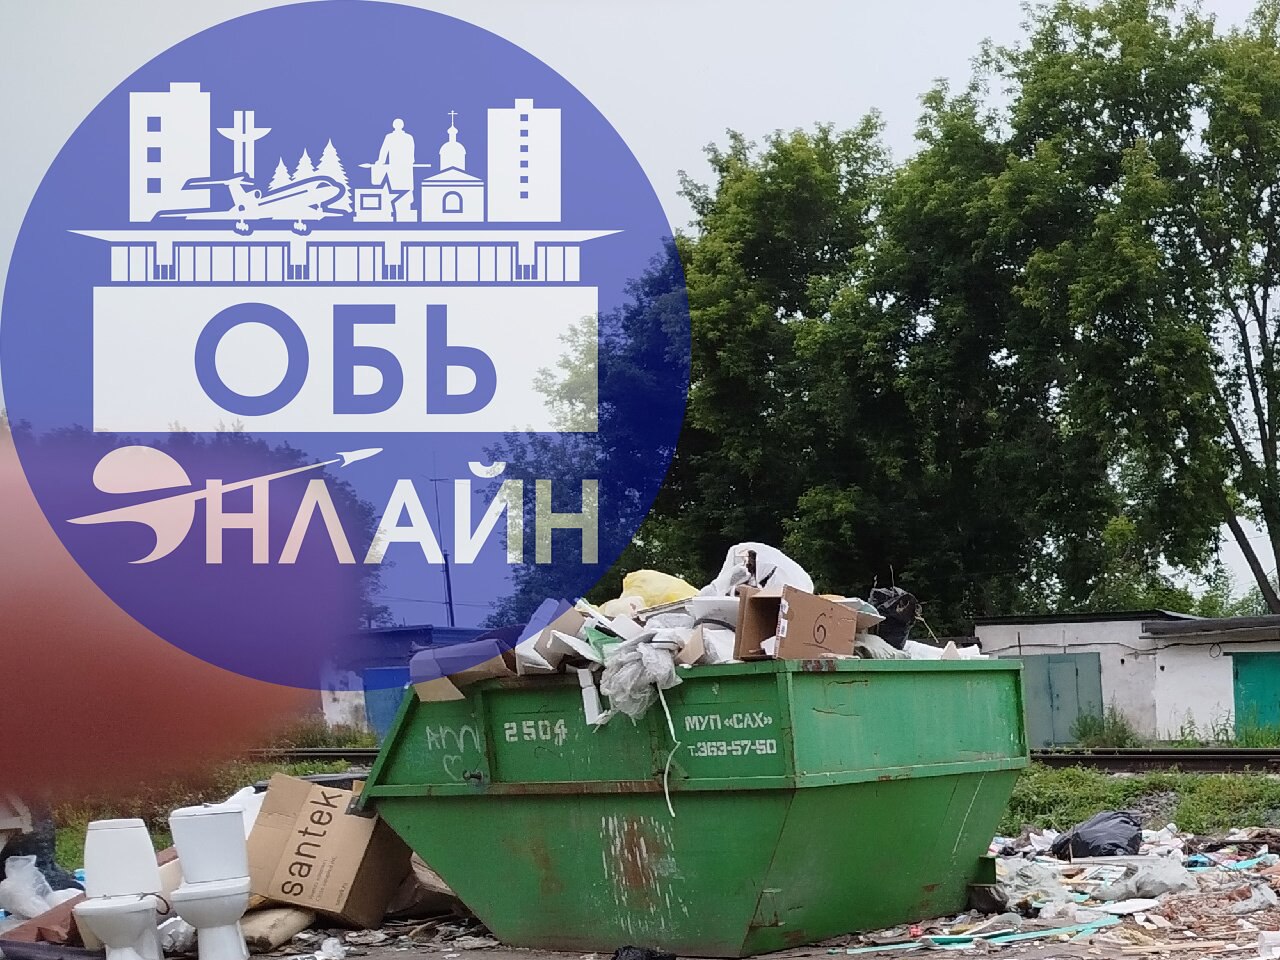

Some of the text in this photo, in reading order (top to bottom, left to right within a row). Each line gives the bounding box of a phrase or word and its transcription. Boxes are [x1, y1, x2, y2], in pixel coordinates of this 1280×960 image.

[503, 718, 569, 746] 2504
[684, 711, 773, 732] МУП «САХ»
[281, 790, 343, 897] santek
